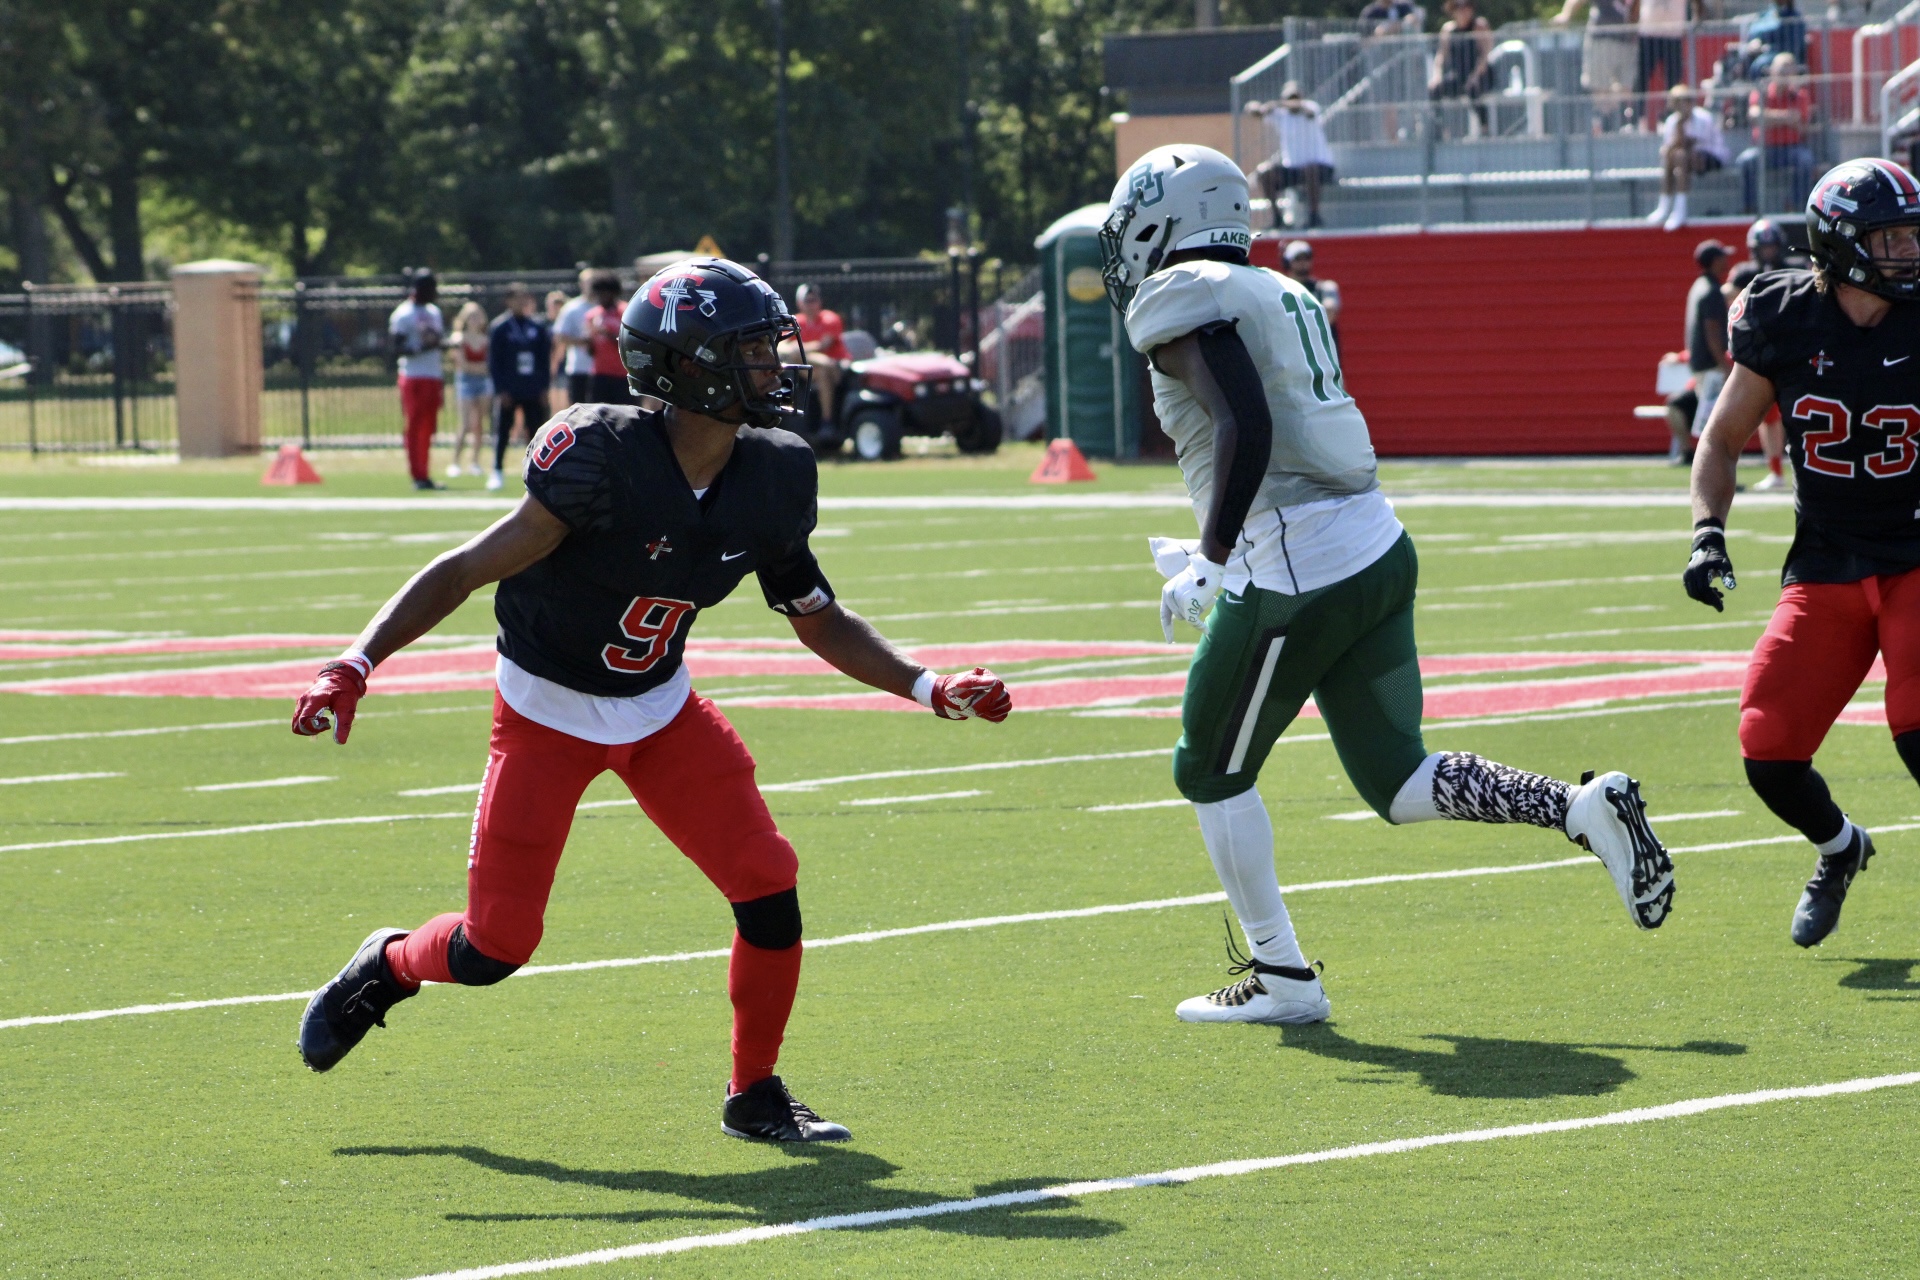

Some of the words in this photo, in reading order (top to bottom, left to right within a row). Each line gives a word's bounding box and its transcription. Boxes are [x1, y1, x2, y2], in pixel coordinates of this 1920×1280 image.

[1128, 162, 1165, 209] RU
[1210, 231, 1251, 249] LAKERS
[1281, 291, 1351, 403] 11
[532, 421, 576, 472] 9
[1792, 393, 1920, 479] 23
[601, 595, 697, 674] 9
